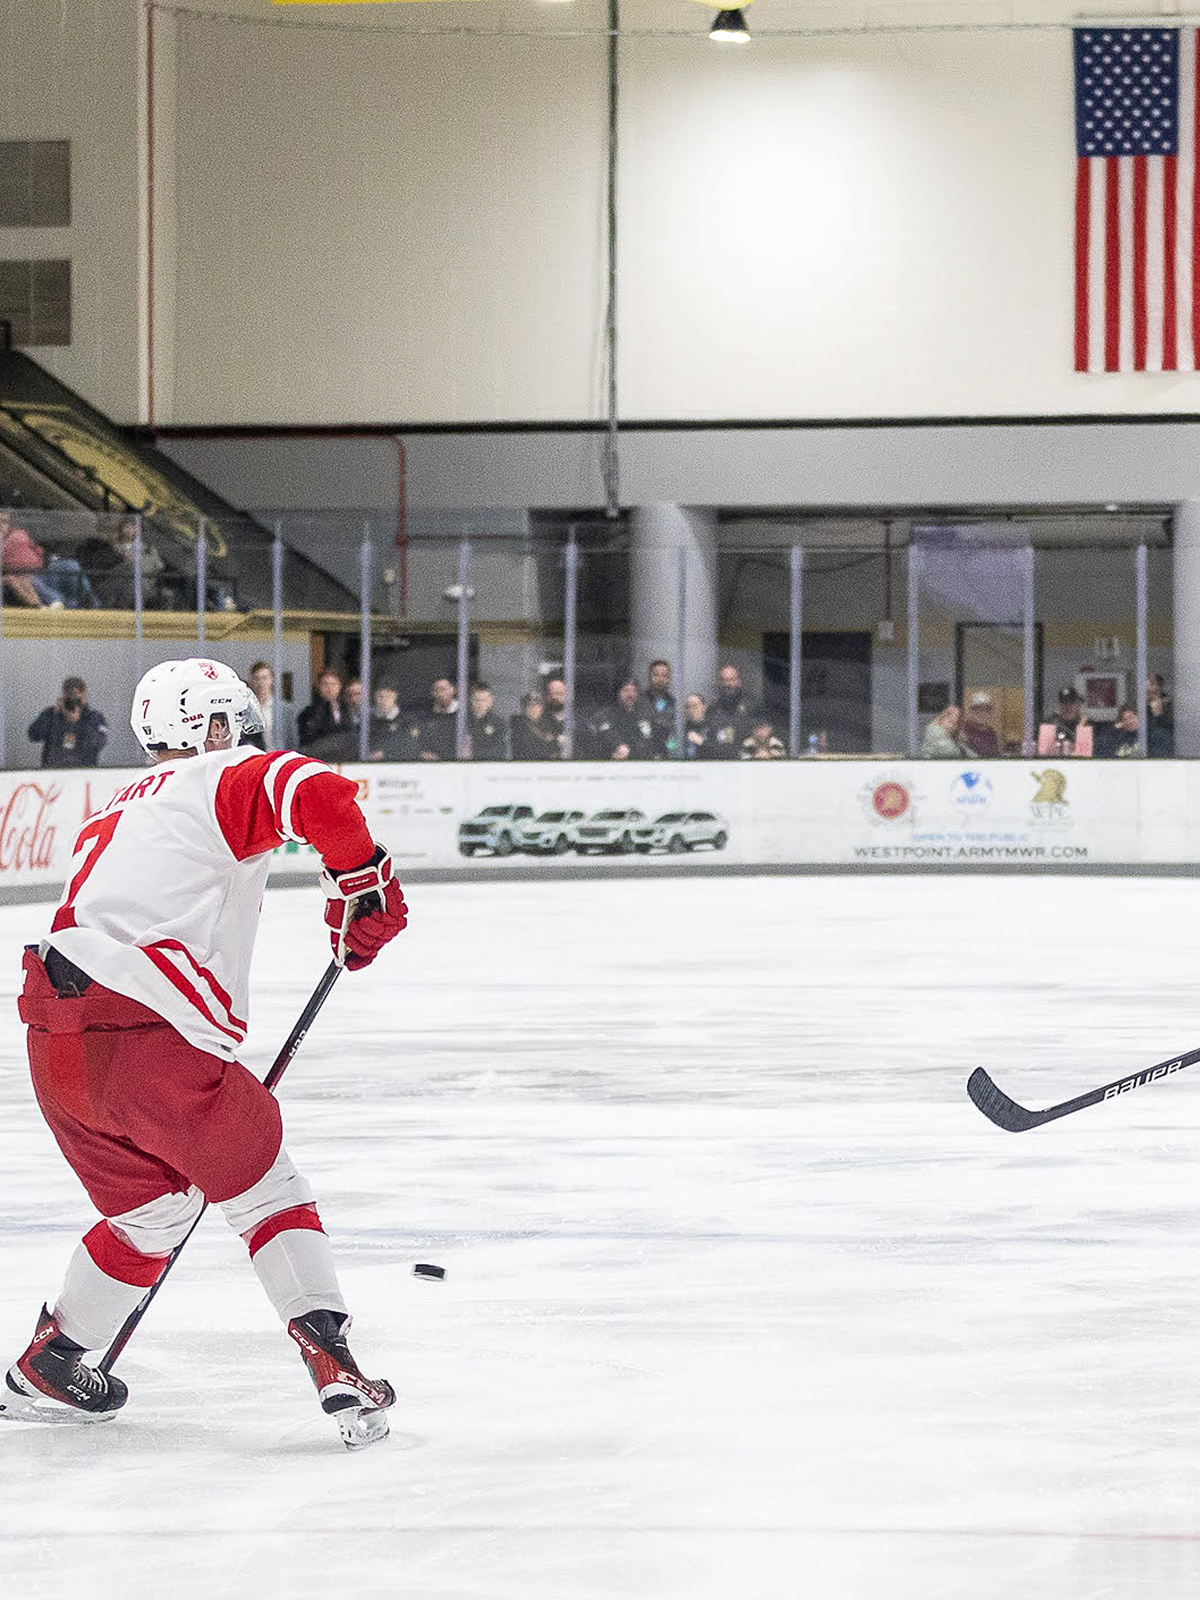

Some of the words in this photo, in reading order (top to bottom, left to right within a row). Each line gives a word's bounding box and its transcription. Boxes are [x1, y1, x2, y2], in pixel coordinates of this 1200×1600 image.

[142, 699, 151, 720] 7
[181, 713, 205, 724] OUA
[50, 809, 125, 934] 7
[33, 1326, 54, 1344] CCM
[291, 1328, 319, 1355] CCM
[66, 1384, 91, 1401] CCM
